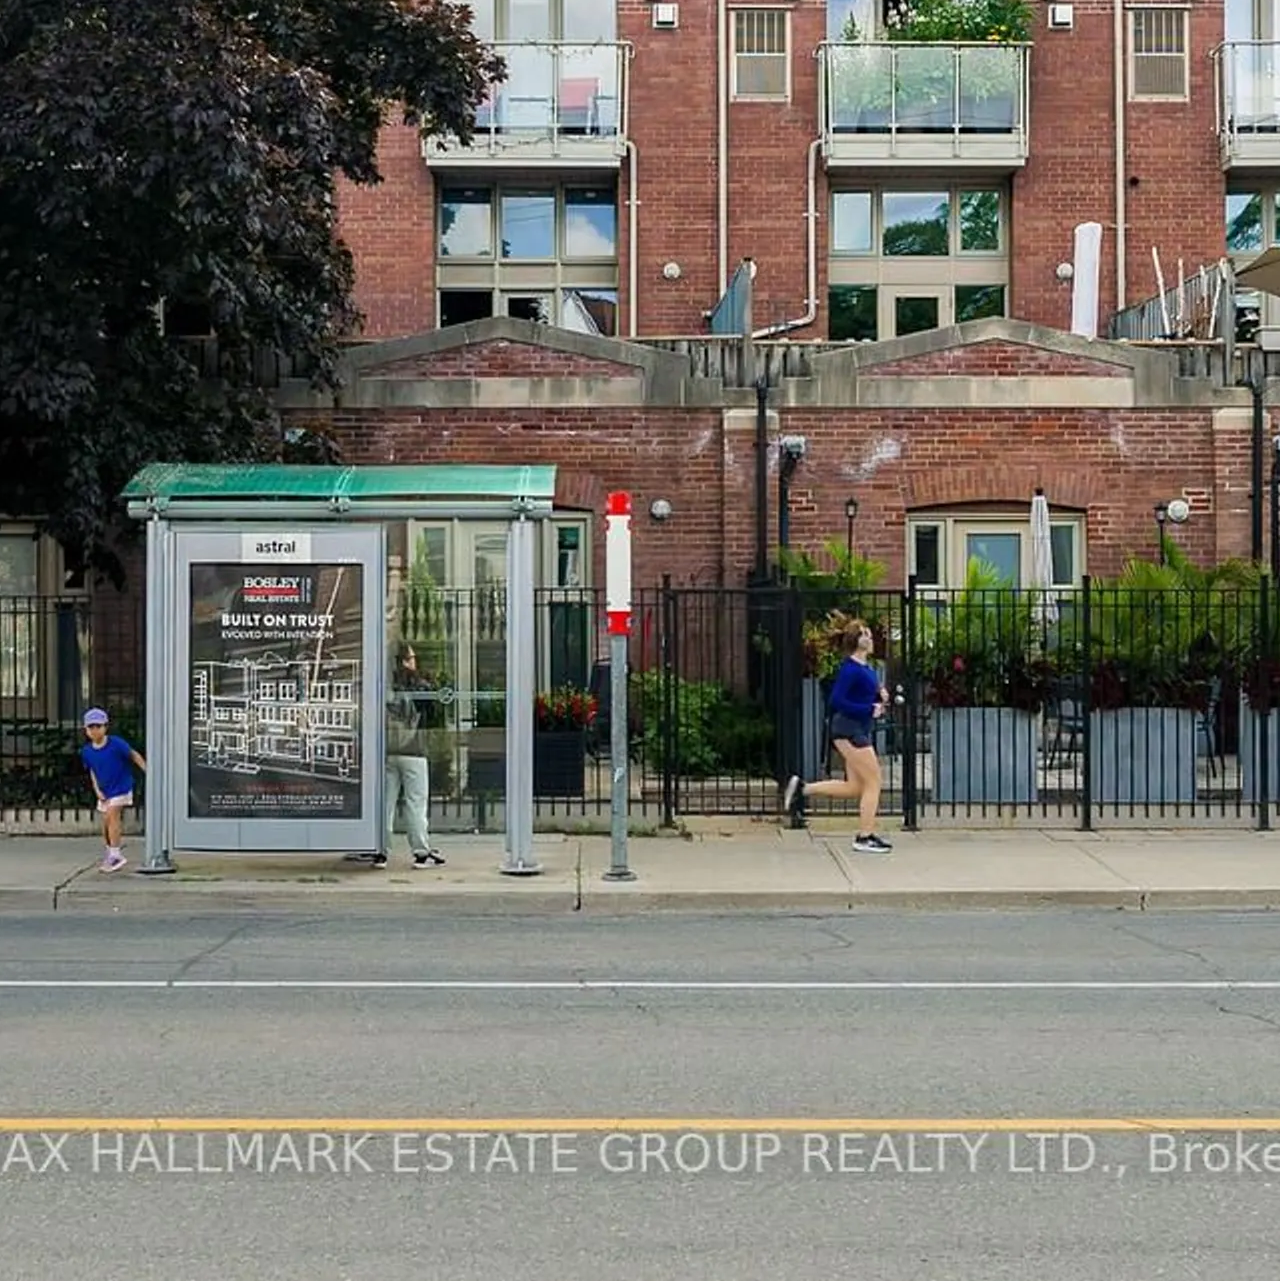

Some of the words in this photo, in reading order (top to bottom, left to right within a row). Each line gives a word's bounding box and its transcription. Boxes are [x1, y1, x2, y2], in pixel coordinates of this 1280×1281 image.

[256, 541, 296, 554] astral
[244, 577, 299, 588] BOSLEY
[221, 613, 261, 627] BUILT
[263, 613, 287, 627] ON
[289, 613, 335, 627] TRUST
[263, 630, 286, 639] WITH
